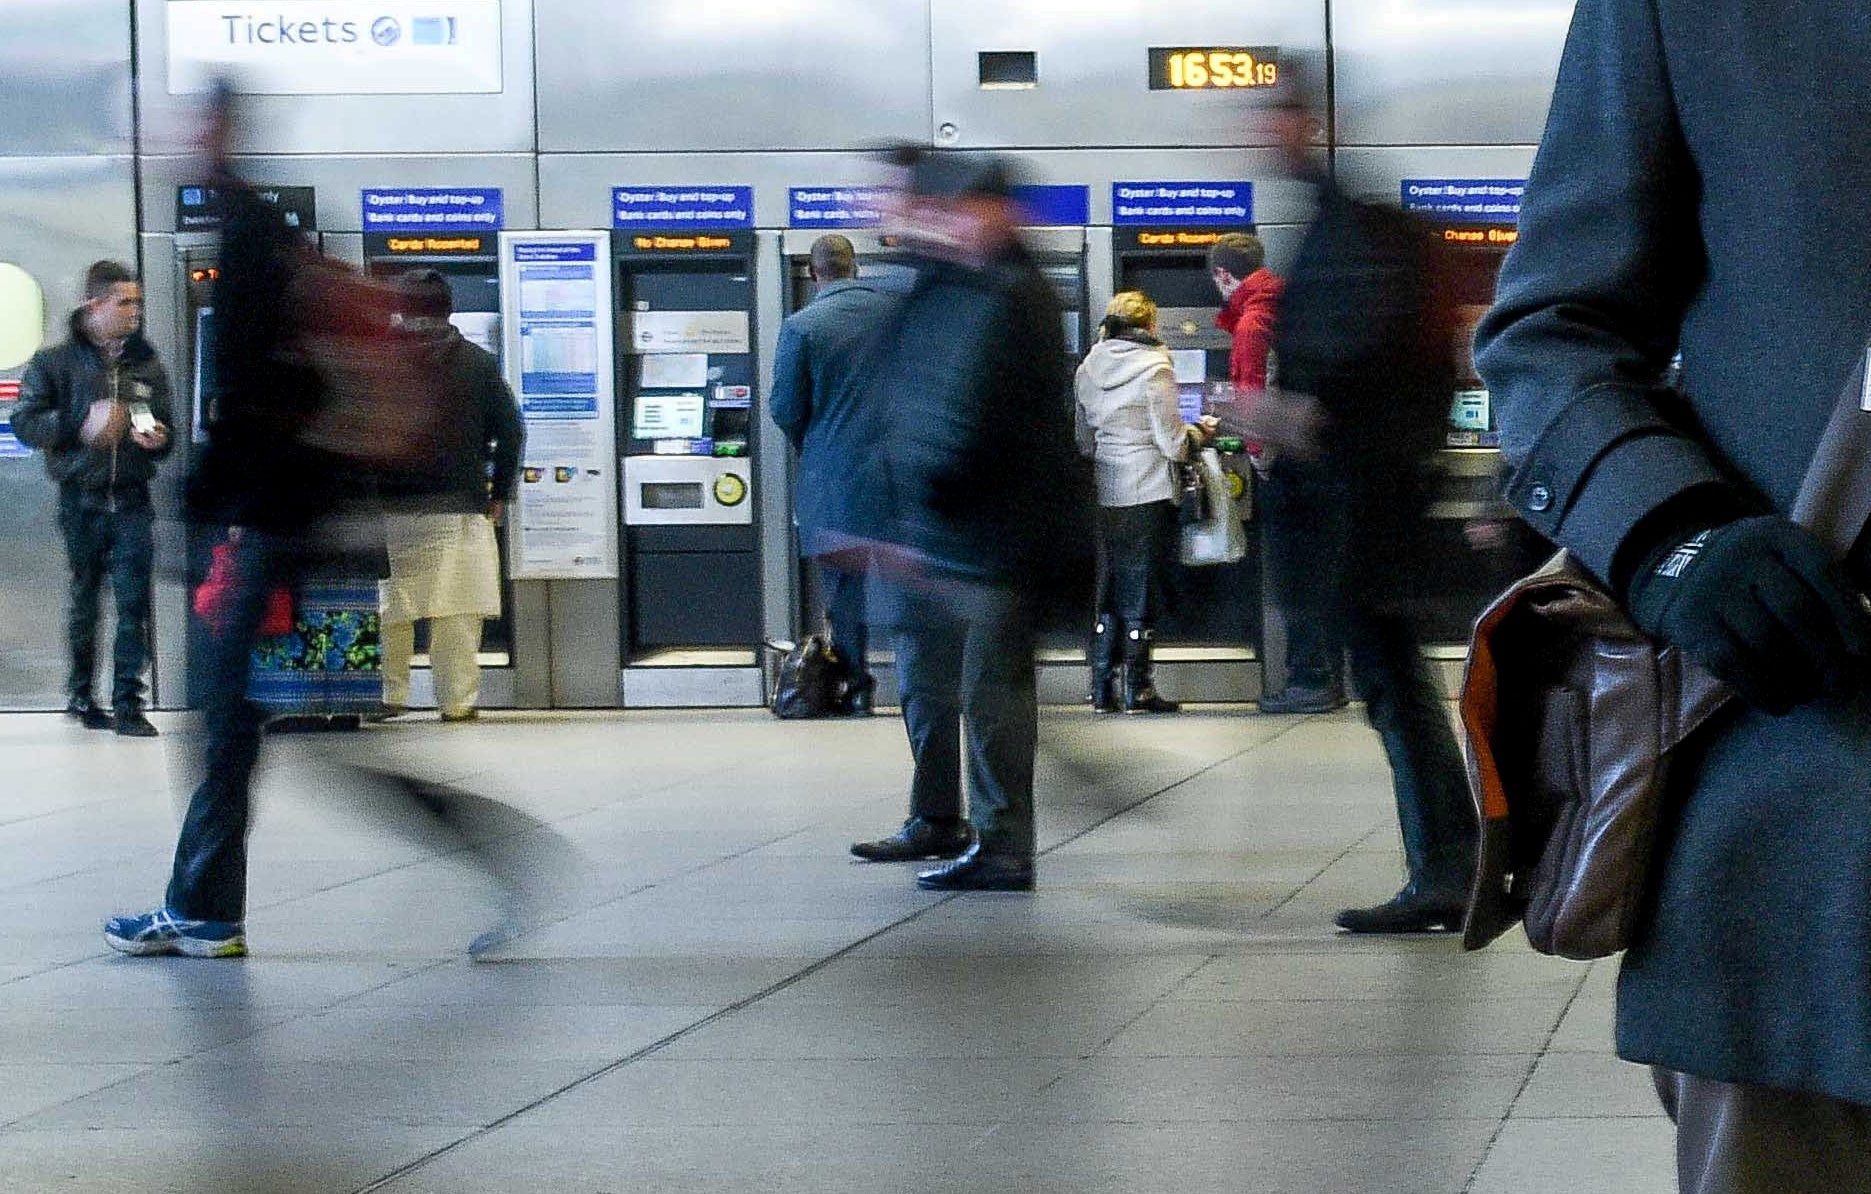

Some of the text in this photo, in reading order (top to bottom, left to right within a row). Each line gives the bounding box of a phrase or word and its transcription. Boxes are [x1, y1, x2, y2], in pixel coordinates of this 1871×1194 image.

[221, 15, 357, 44] Tickets
[1179, 188, 1199, 198] and
[1447, 185, 1466, 197] Buy
[1467, 185, 1488, 196] and
[428, 194, 448, 204] and
[679, 192, 699, 202] and
[1175, 206, 1195, 216] and
[1223, 206, 1247, 217] only
[1463, 203, 1483, 213] and
[425, 212, 443, 222] and
[474, 212, 496, 223] only
[675, 210, 695, 220] and
[724, 210, 746, 221] only
